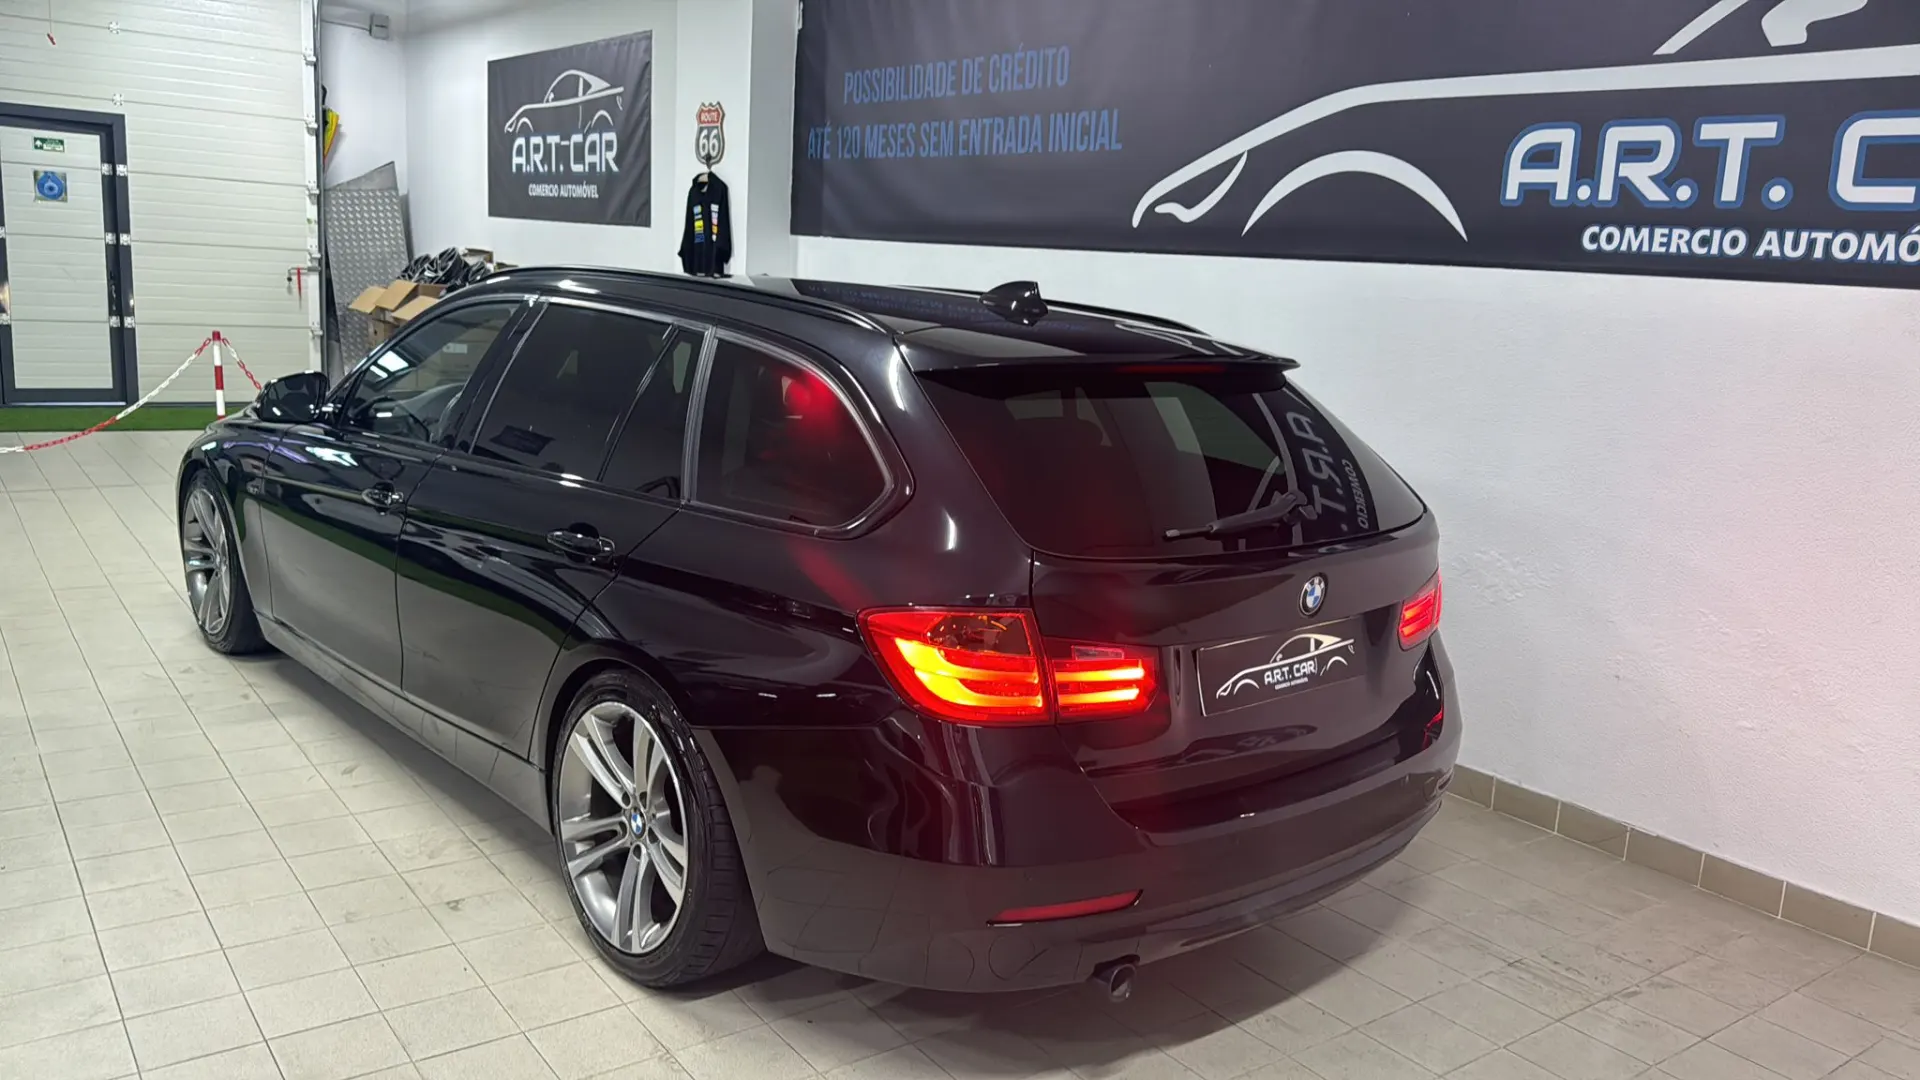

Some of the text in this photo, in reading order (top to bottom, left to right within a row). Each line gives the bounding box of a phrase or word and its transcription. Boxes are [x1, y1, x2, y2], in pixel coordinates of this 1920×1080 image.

[843, 42, 1070, 104] POSSIBILIDADE DE CRÉDITO
[699, 129, 719, 158] 66
[807, 108, 1123, 160] ATÉ 120 MESES SEM ENTRADA INICIAL
[1503, 118, 1789, 207] A.R.T.
[528, 180, 599, 199] COMERCIO AUTOMÓVEL
[1581, 224, 1749, 257] COMERCIO
[1293, 660, 1315, 678] CAR
